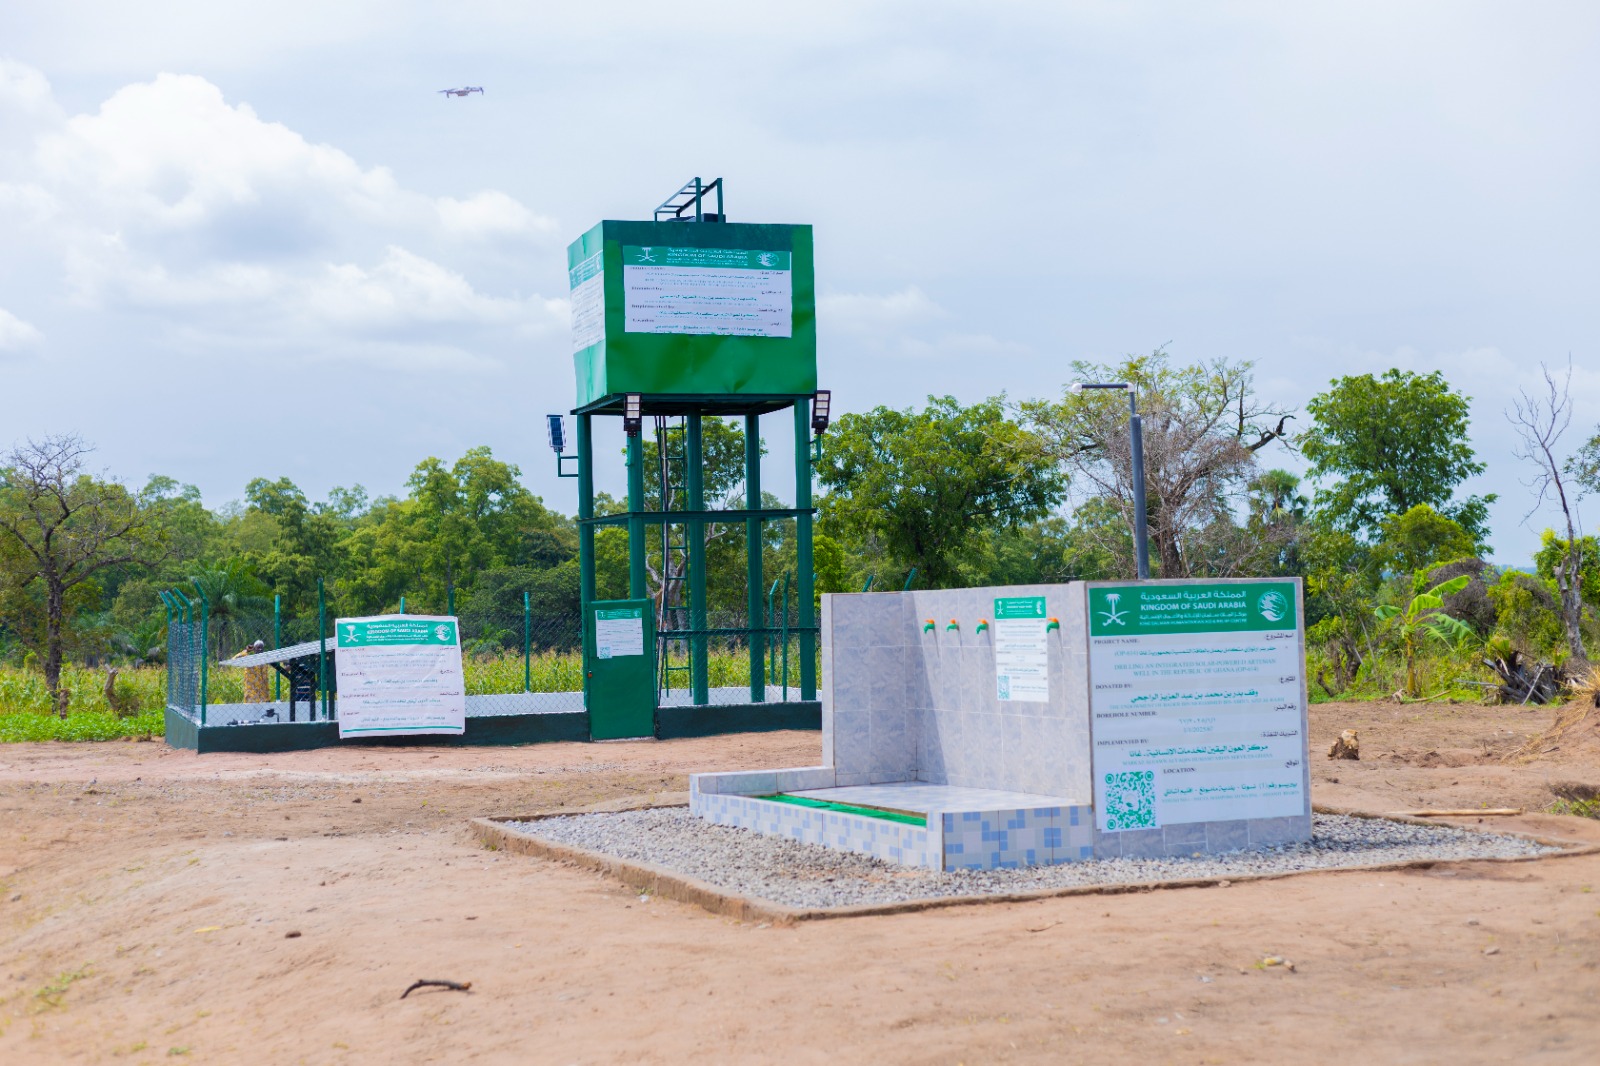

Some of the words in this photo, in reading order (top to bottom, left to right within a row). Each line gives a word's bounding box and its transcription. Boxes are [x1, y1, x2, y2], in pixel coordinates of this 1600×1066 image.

[1140, 591, 1182, 602] السعودية
[1183, 591, 1212, 602] العربية
[1213, 590, 1247, 599] المملكة
[1140, 603, 1180, 611] KINGDOM
[1192, 602, 1217, 610] SAUDI
[1218, 601, 1247, 609] ARABIA
[1097, 738, 1140, 746] IMPLEMENTED
